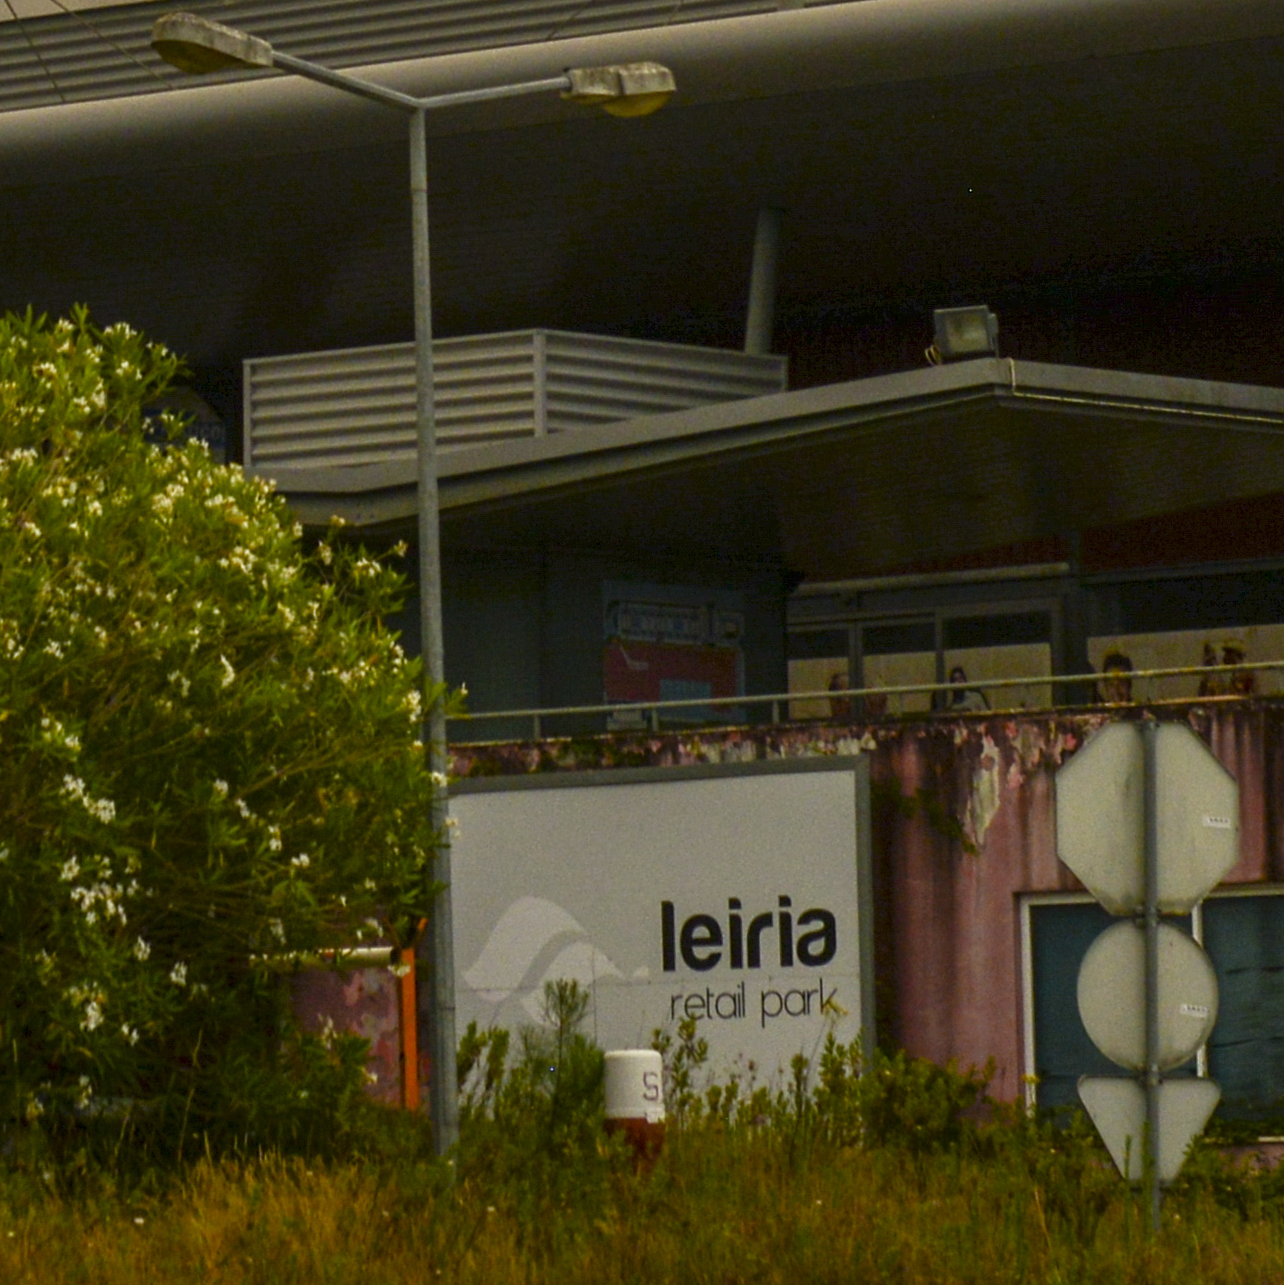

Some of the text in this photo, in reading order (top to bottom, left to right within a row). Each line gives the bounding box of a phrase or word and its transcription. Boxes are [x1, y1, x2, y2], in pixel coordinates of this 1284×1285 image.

[661, 895, 837, 971] leiria
[670, 978, 840, 1029] retail park
